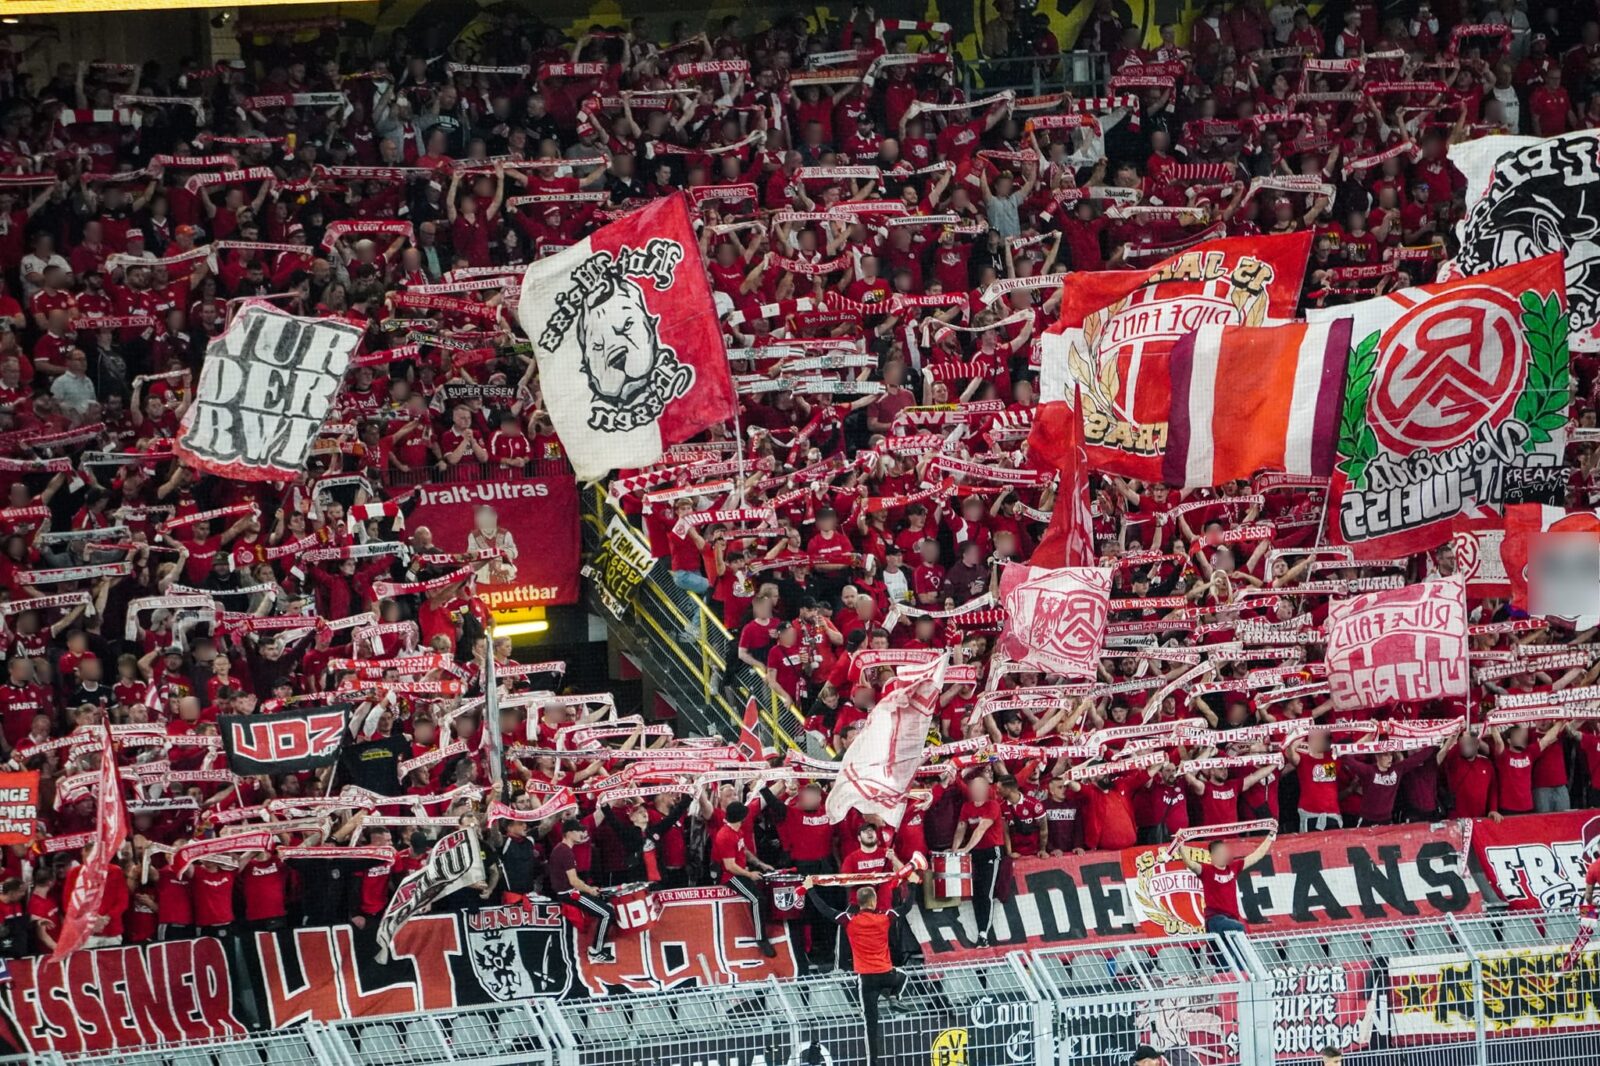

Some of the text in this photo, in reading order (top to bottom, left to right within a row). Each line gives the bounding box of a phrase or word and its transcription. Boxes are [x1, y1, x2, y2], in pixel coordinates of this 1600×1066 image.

[200, 360, 340, 417] DER
[448, 387, 515, 397] SUPER ESSEN
[992, 470, 1021, 480] ESSEN
[1505, 467, 1572, 485] FREAKS
[685, 513, 713, 526] NUR
[716, 510, 741, 522] DER
[1308, 631, 1326, 642] UL
[122, 738, 164, 748] SÄNGE
[231, 710, 346, 763] UDZ
[1071, 752, 1166, 781] RUDE FANS
[605, 788, 640, 799] ESSEN
[1151, 874, 1201, 893] RUDE FAN
[1237, 841, 1471, 927] FANS
[659, 890, 673, 902] FÜR
[674, 889, 699, 901] IMMER
[8, 936, 250, 1057] ESSENER
